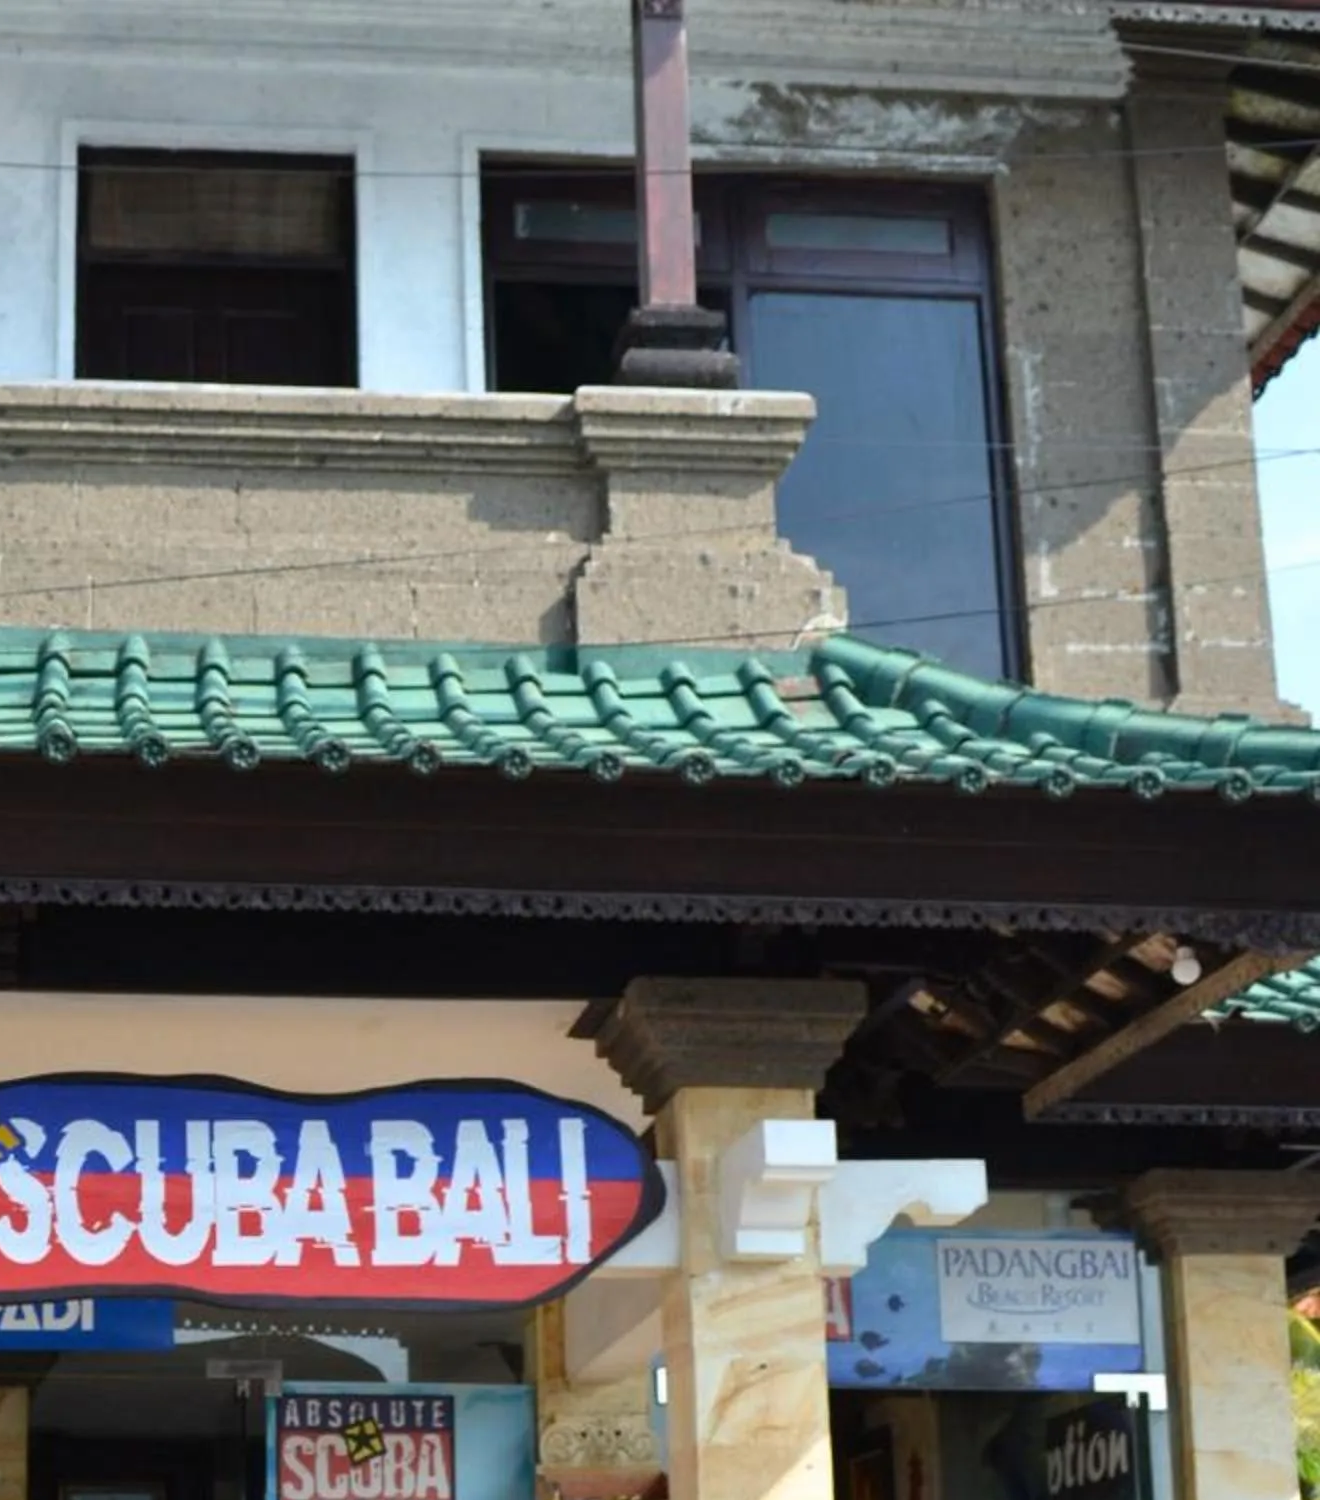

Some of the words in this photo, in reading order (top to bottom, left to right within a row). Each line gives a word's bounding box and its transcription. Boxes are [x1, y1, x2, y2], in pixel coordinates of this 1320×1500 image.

[363, 1117, 592, 1266] BALI
[943, 1248, 1130, 1280] PADANGBAI
[284, 1398, 445, 1428] ABSOLUTE
[282, 1433, 451, 1500] SCUBA
